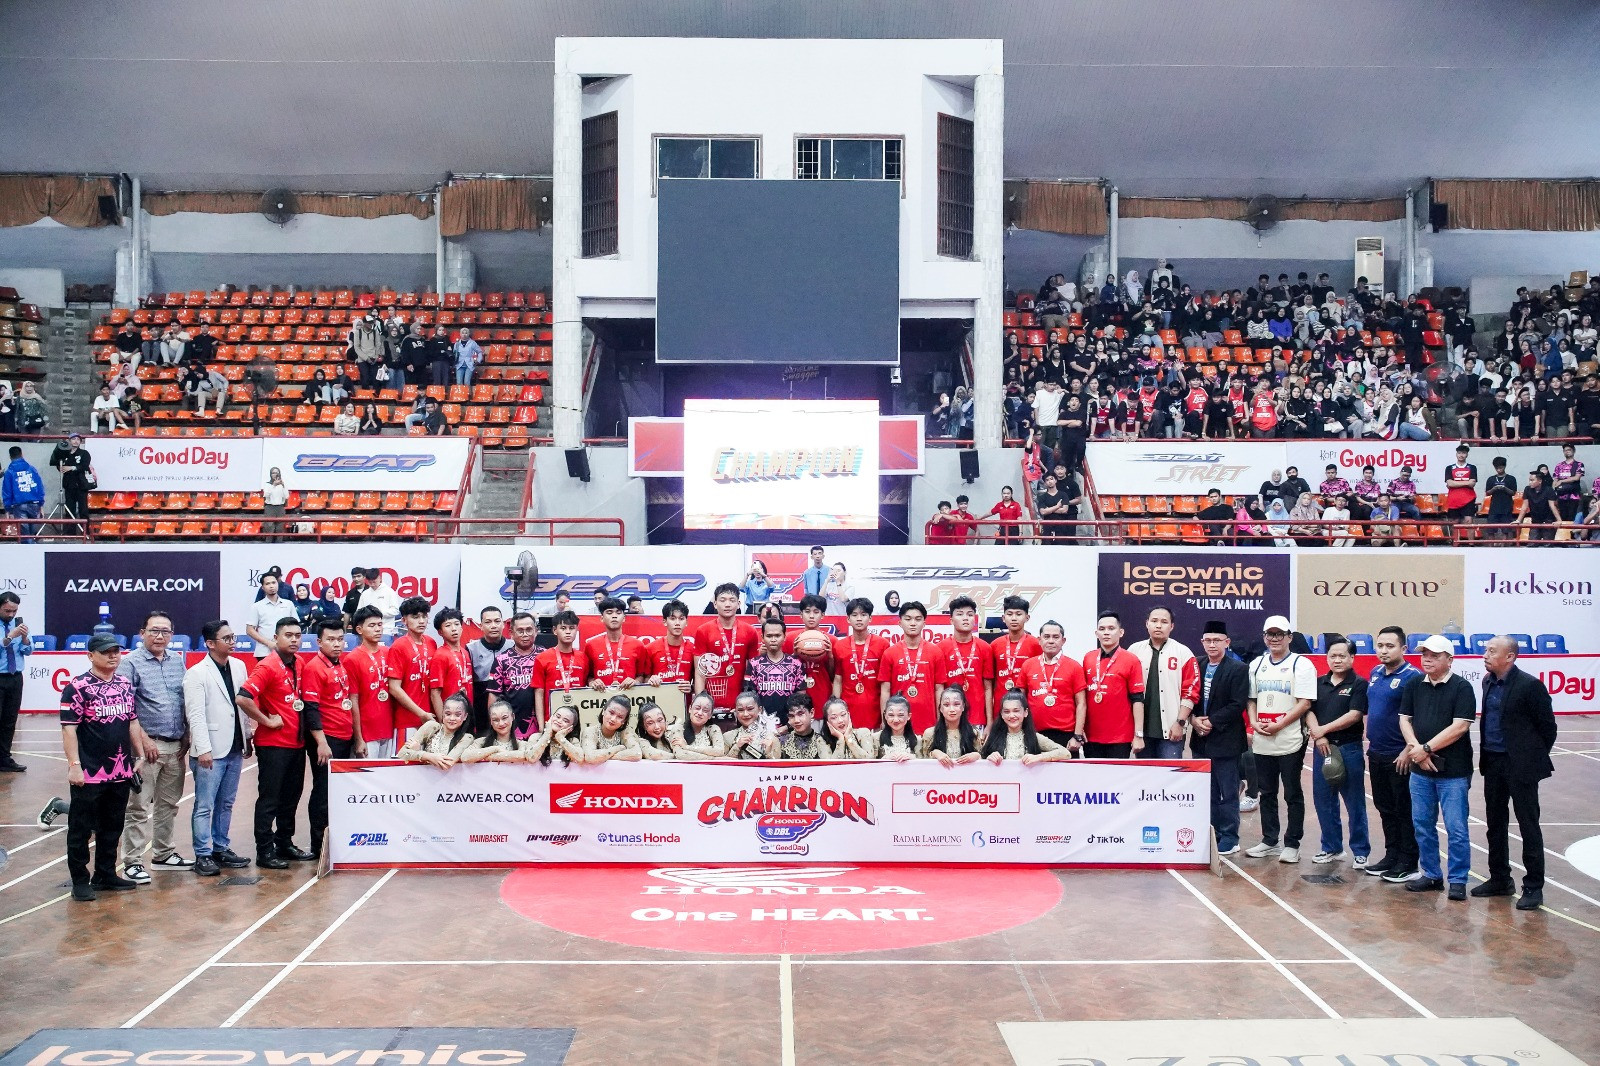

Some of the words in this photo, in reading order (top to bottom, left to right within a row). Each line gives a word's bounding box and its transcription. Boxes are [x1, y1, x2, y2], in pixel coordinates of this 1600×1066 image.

[710, 447, 863, 484] CHAMPION
[1155, 464, 1250, 483] STREET
[64, 578, 204, 593] AZAWEAR.COM
[1123, 582, 1165, 595] ICE
[1168, 582, 1264, 596] CREAM
[1484, 572, 1592, 595] Jackson
[1196, 599, 1232, 610] ULTRA
[1235, 599, 1264, 610] MILK
[1562, 598, 1593, 606] SHOES
[1168, 656, 1178, 671] G
[436, 793, 534, 803] AZAWEAR.COM
[1036, 793, 1081, 804] ULTRA
[1085, 793, 1120, 804] MILK
[1138, 789, 1194, 802] Jackson
[583, 796, 678, 809] HONDA
[697, 785, 876, 826] CHAMPION
[773, 827, 791, 836] DBL
[469, 835, 509, 843] MAINBASKET
[609, 833, 642, 843] tunas
[643, 833, 681, 843] Honda
[893, 834, 921, 843] RADAR
[922, 834, 962, 843] LAMPUNG
[989, 835, 1020, 844] Biznet
[1096, 836, 1125, 844] TikTok
[639, 885, 926, 895] HONDA
[630, 907, 738, 922] One
[751, 907, 935, 922] HEART.
